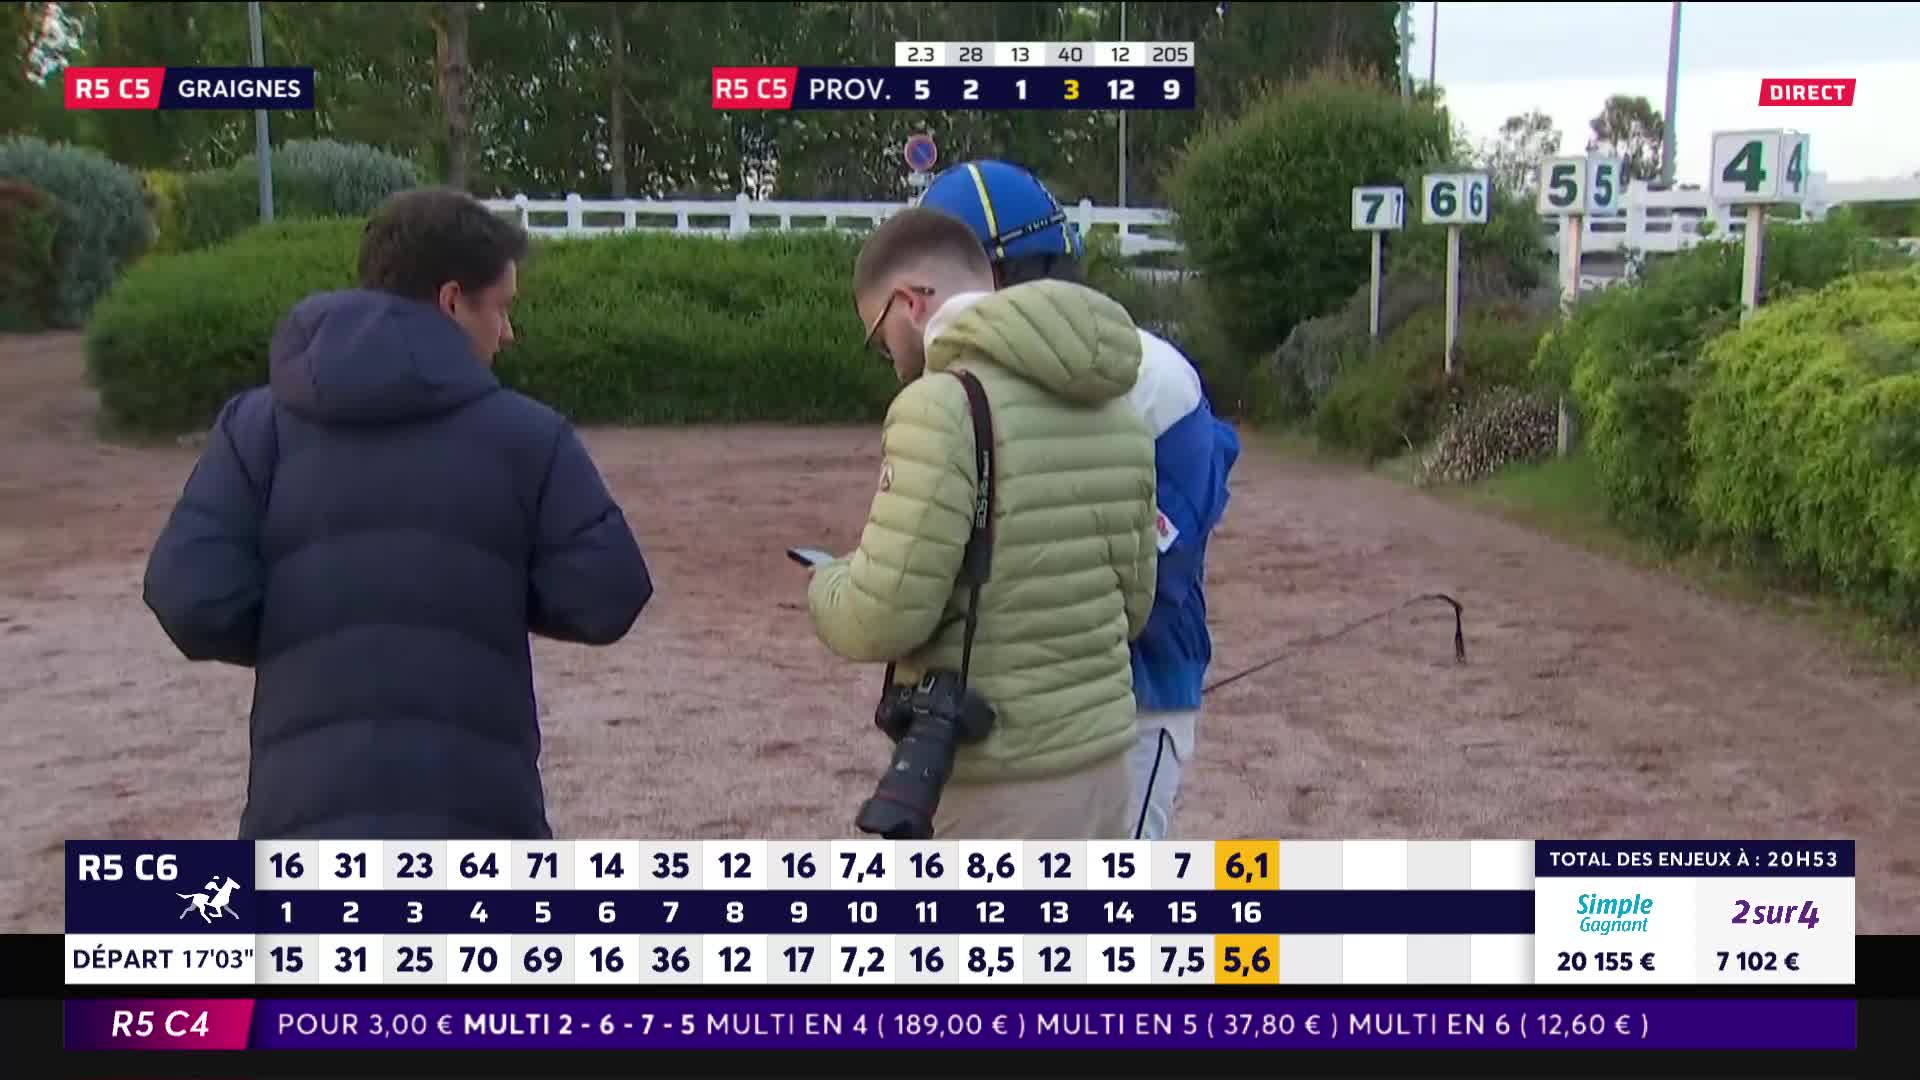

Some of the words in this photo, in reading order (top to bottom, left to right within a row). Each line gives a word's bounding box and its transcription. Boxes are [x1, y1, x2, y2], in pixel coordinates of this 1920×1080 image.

[1549, 165, 1578, 207] 5
[1593, 166, 1614, 207] 5
[1723, 140, 1766, 192] 4
[1786, 141, 1802, 194] 4
[1361, 194, 1385, 224] 7
[1430, 181, 1458, 217] 6
[1469, 182, 1483, 217] 6
